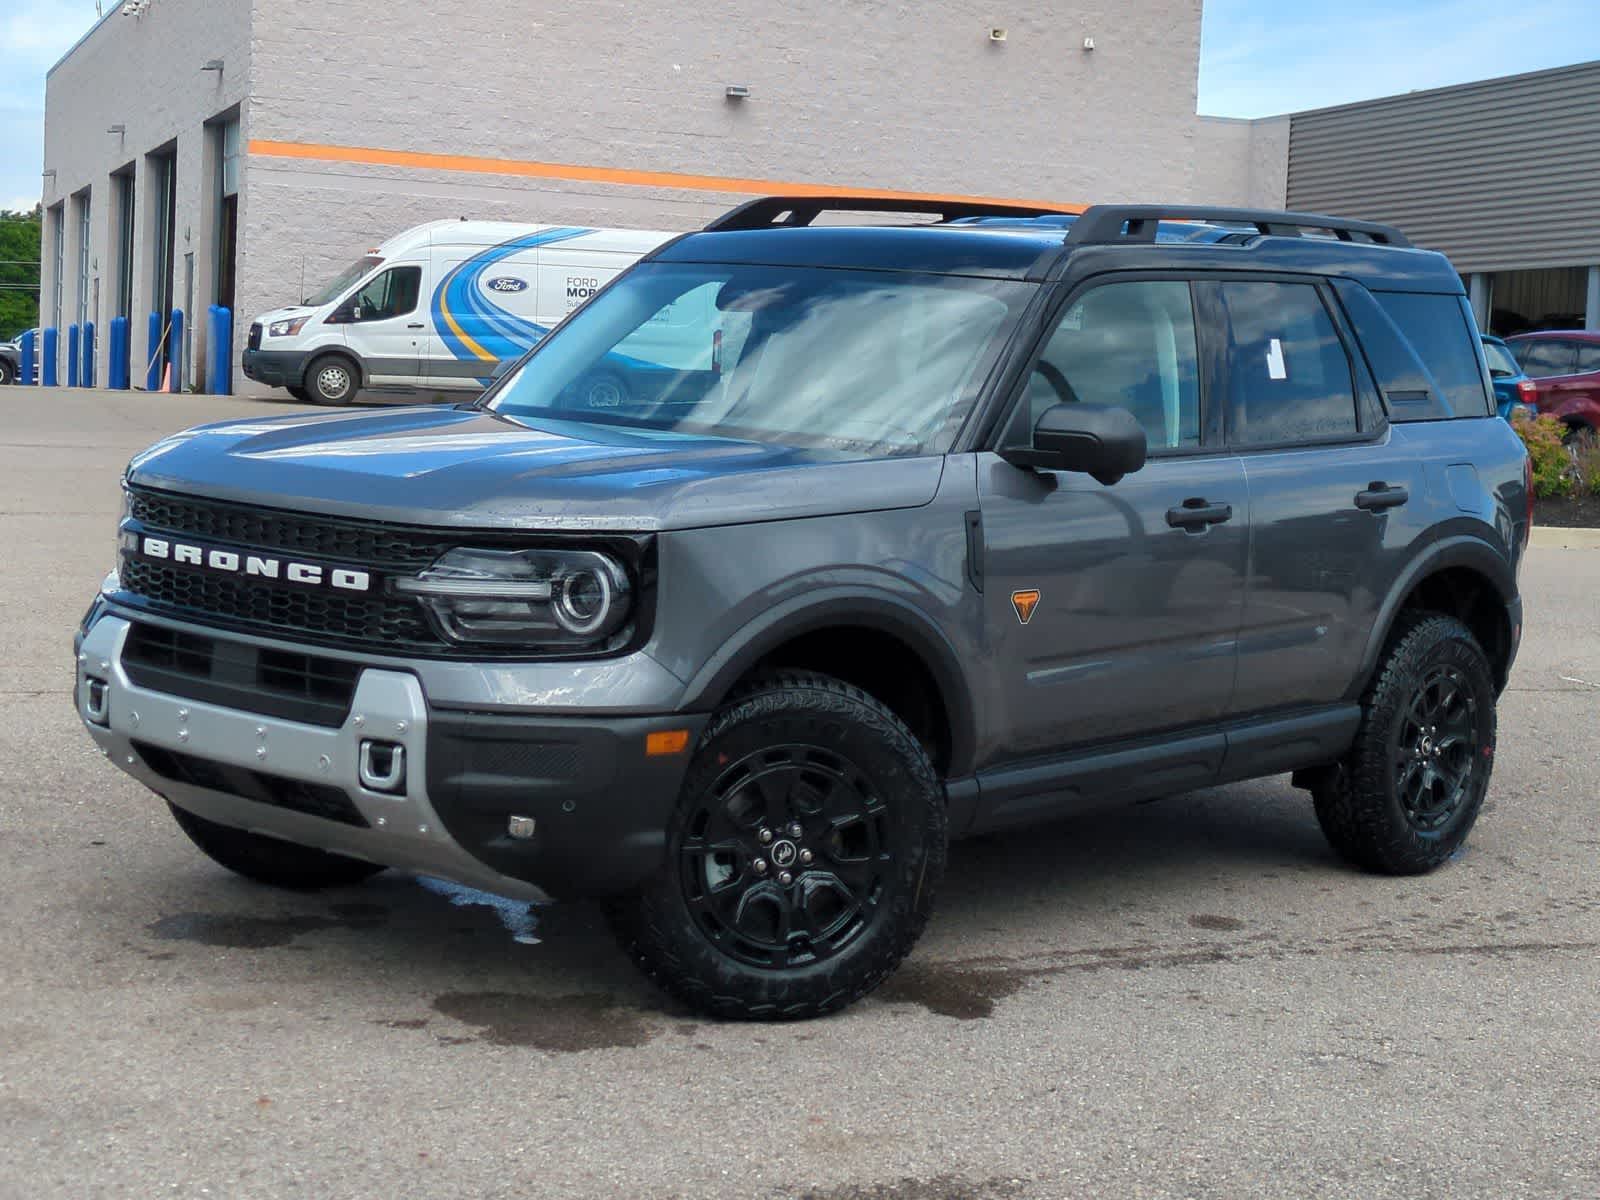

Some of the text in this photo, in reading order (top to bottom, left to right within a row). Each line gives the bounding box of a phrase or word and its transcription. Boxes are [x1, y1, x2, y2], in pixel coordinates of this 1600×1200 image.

[494, 279, 521, 291] Ford
[566, 277, 599, 288] FORD
[143, 537, 370, 592] BRONCO
